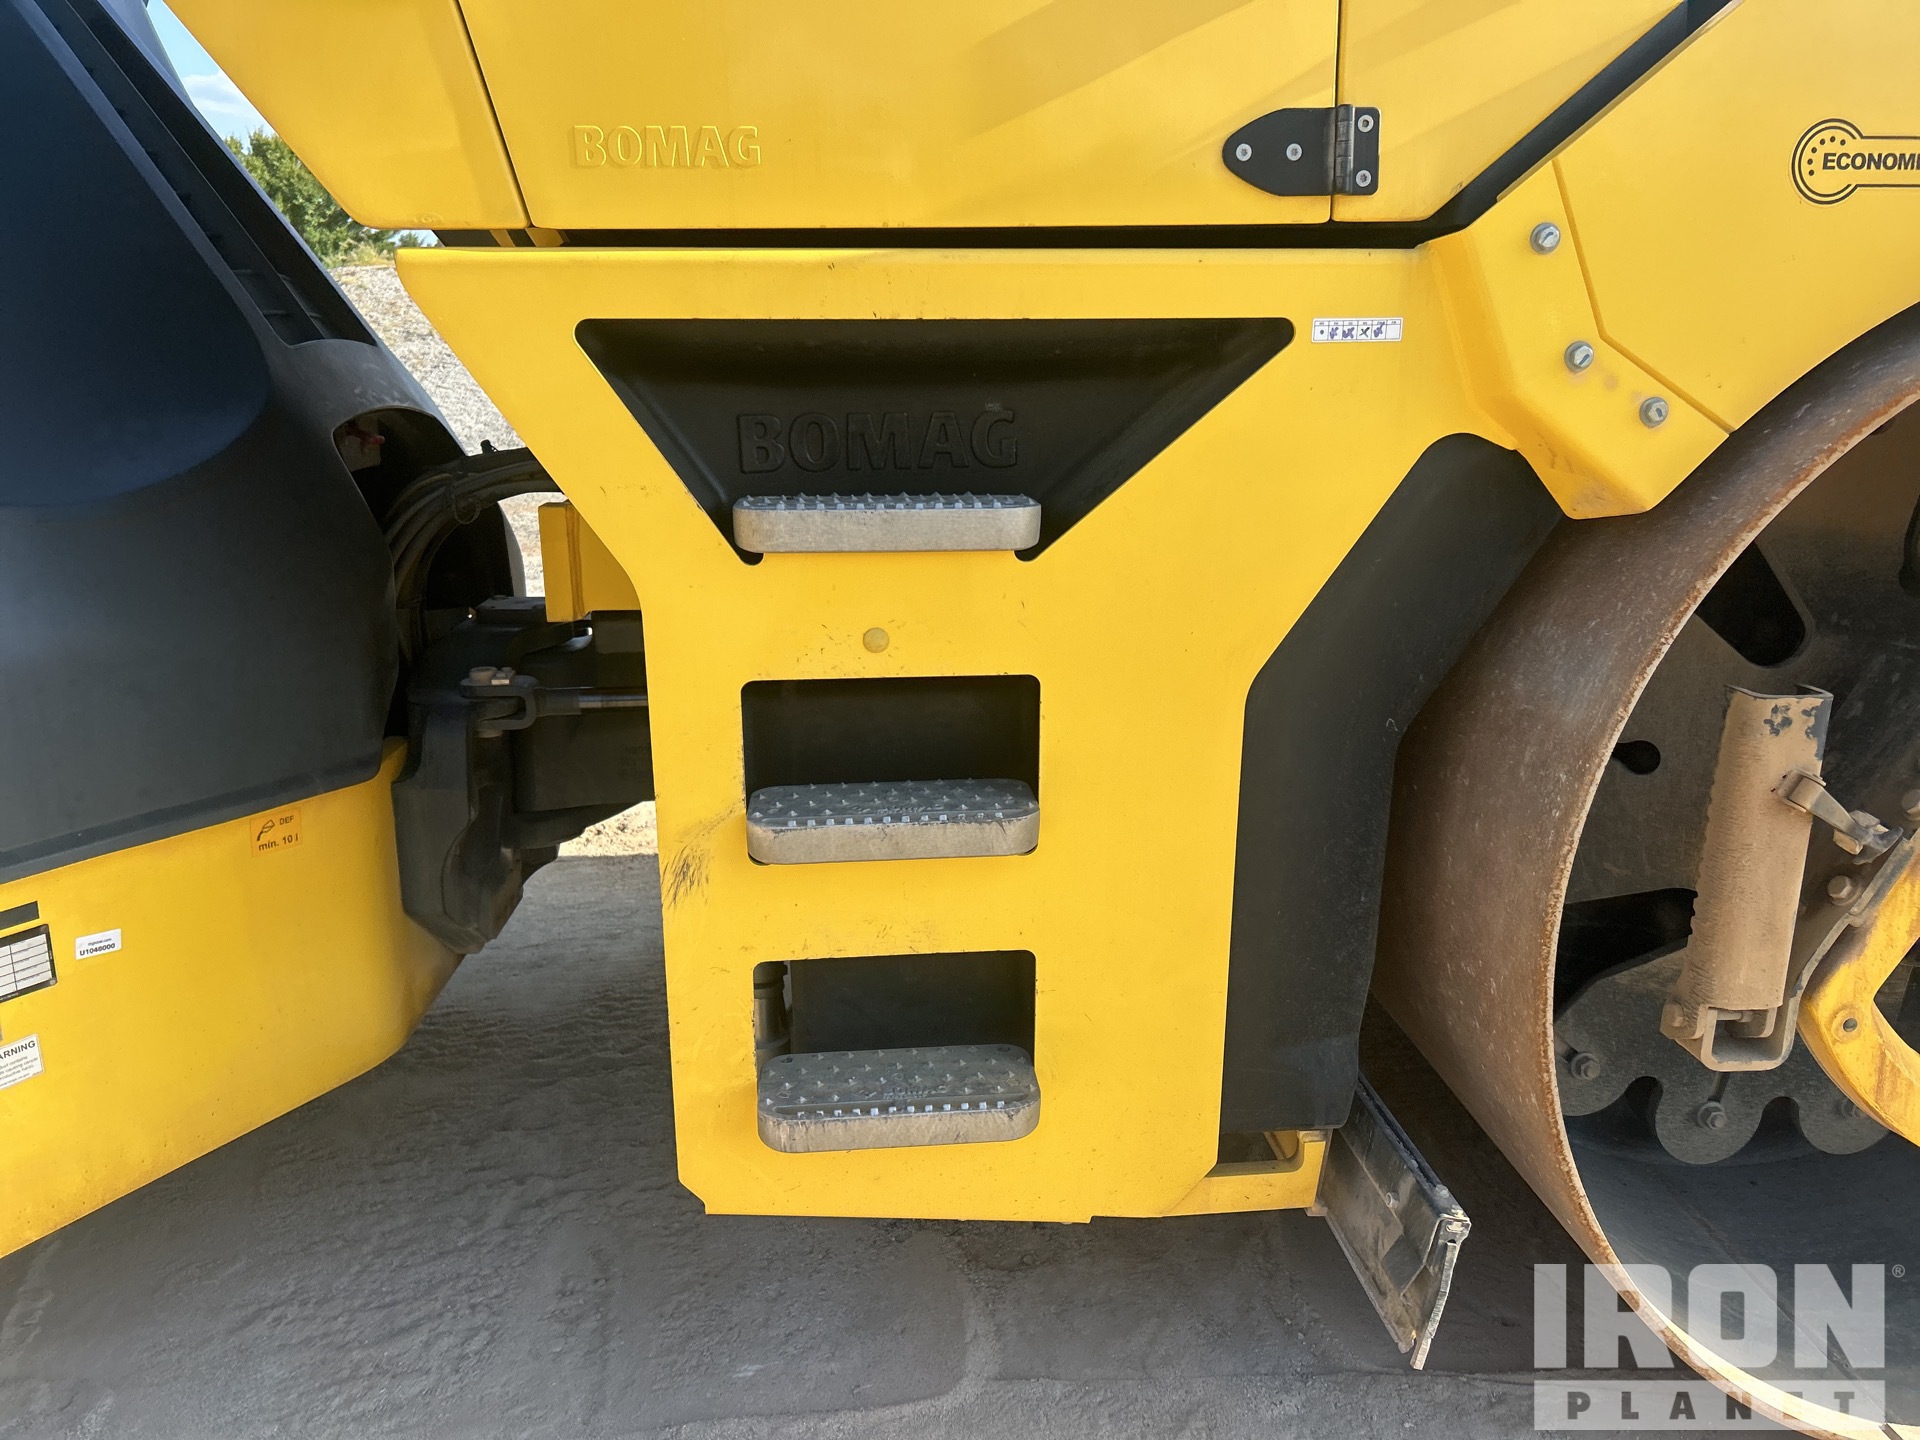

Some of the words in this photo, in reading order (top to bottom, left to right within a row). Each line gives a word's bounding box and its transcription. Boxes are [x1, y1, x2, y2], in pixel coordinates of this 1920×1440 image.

[570, 125, 762, 168] BOMAG
[736, 410, 1018, 474] BOMAG
[279, 815, 294, 825] DEF
[258, 841, 279, 851] min.
[282, 834, 293, 845] 10
